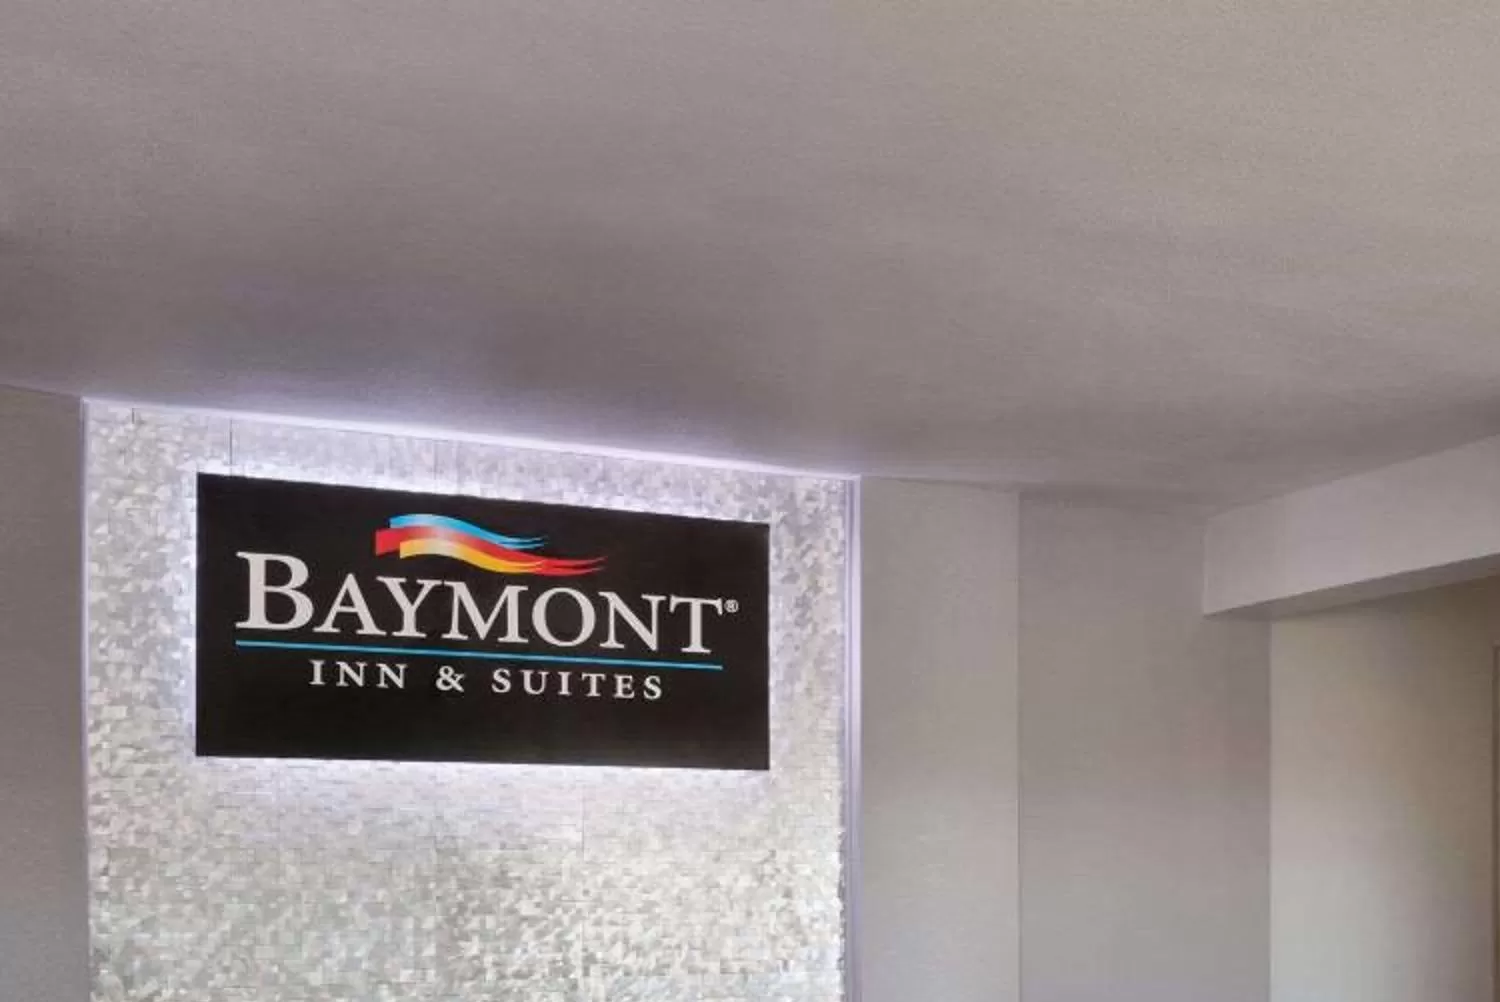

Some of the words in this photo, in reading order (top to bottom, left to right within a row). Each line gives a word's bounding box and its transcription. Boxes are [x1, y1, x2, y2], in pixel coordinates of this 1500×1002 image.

[309, 659, 408, 690] INN
[435, 664, 465, 693] &
[491, 667, 663, 700] SUITES
